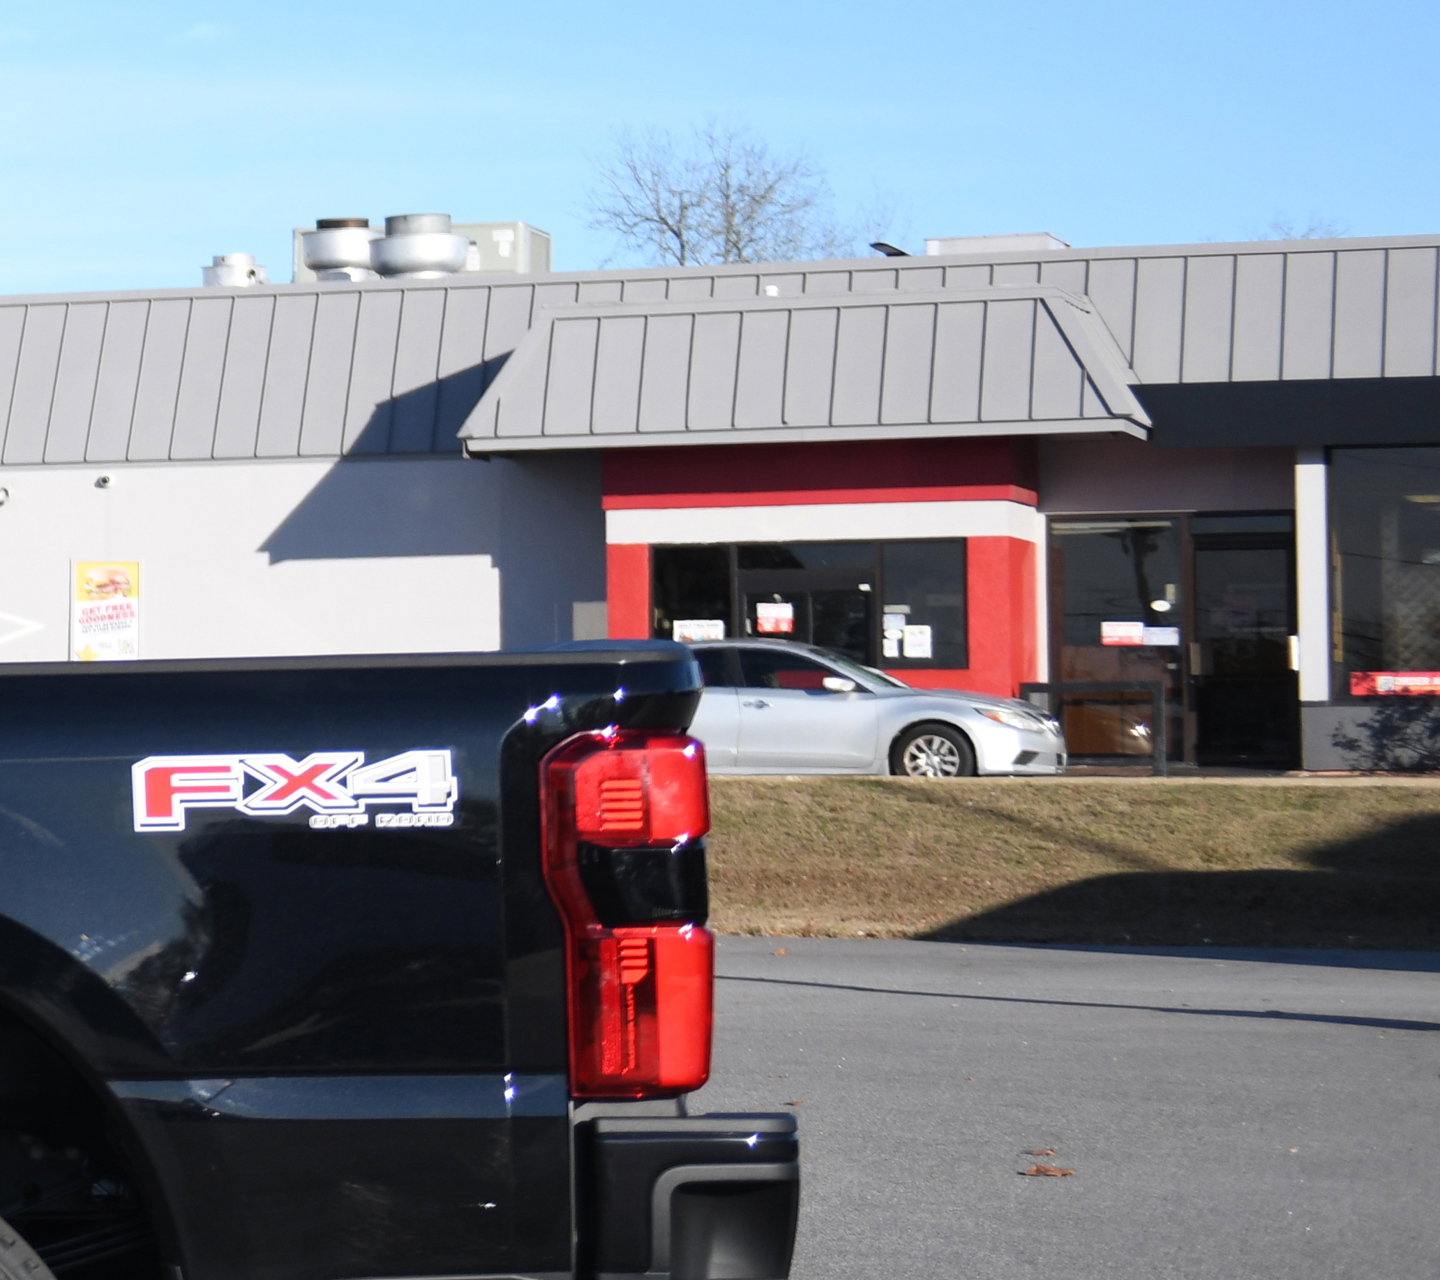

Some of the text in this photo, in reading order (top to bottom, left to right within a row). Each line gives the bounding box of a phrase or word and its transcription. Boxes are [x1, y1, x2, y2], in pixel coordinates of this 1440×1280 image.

[132, 749, 458, 832] FX4
[309, 812, 455, 829] OFF ROAD
